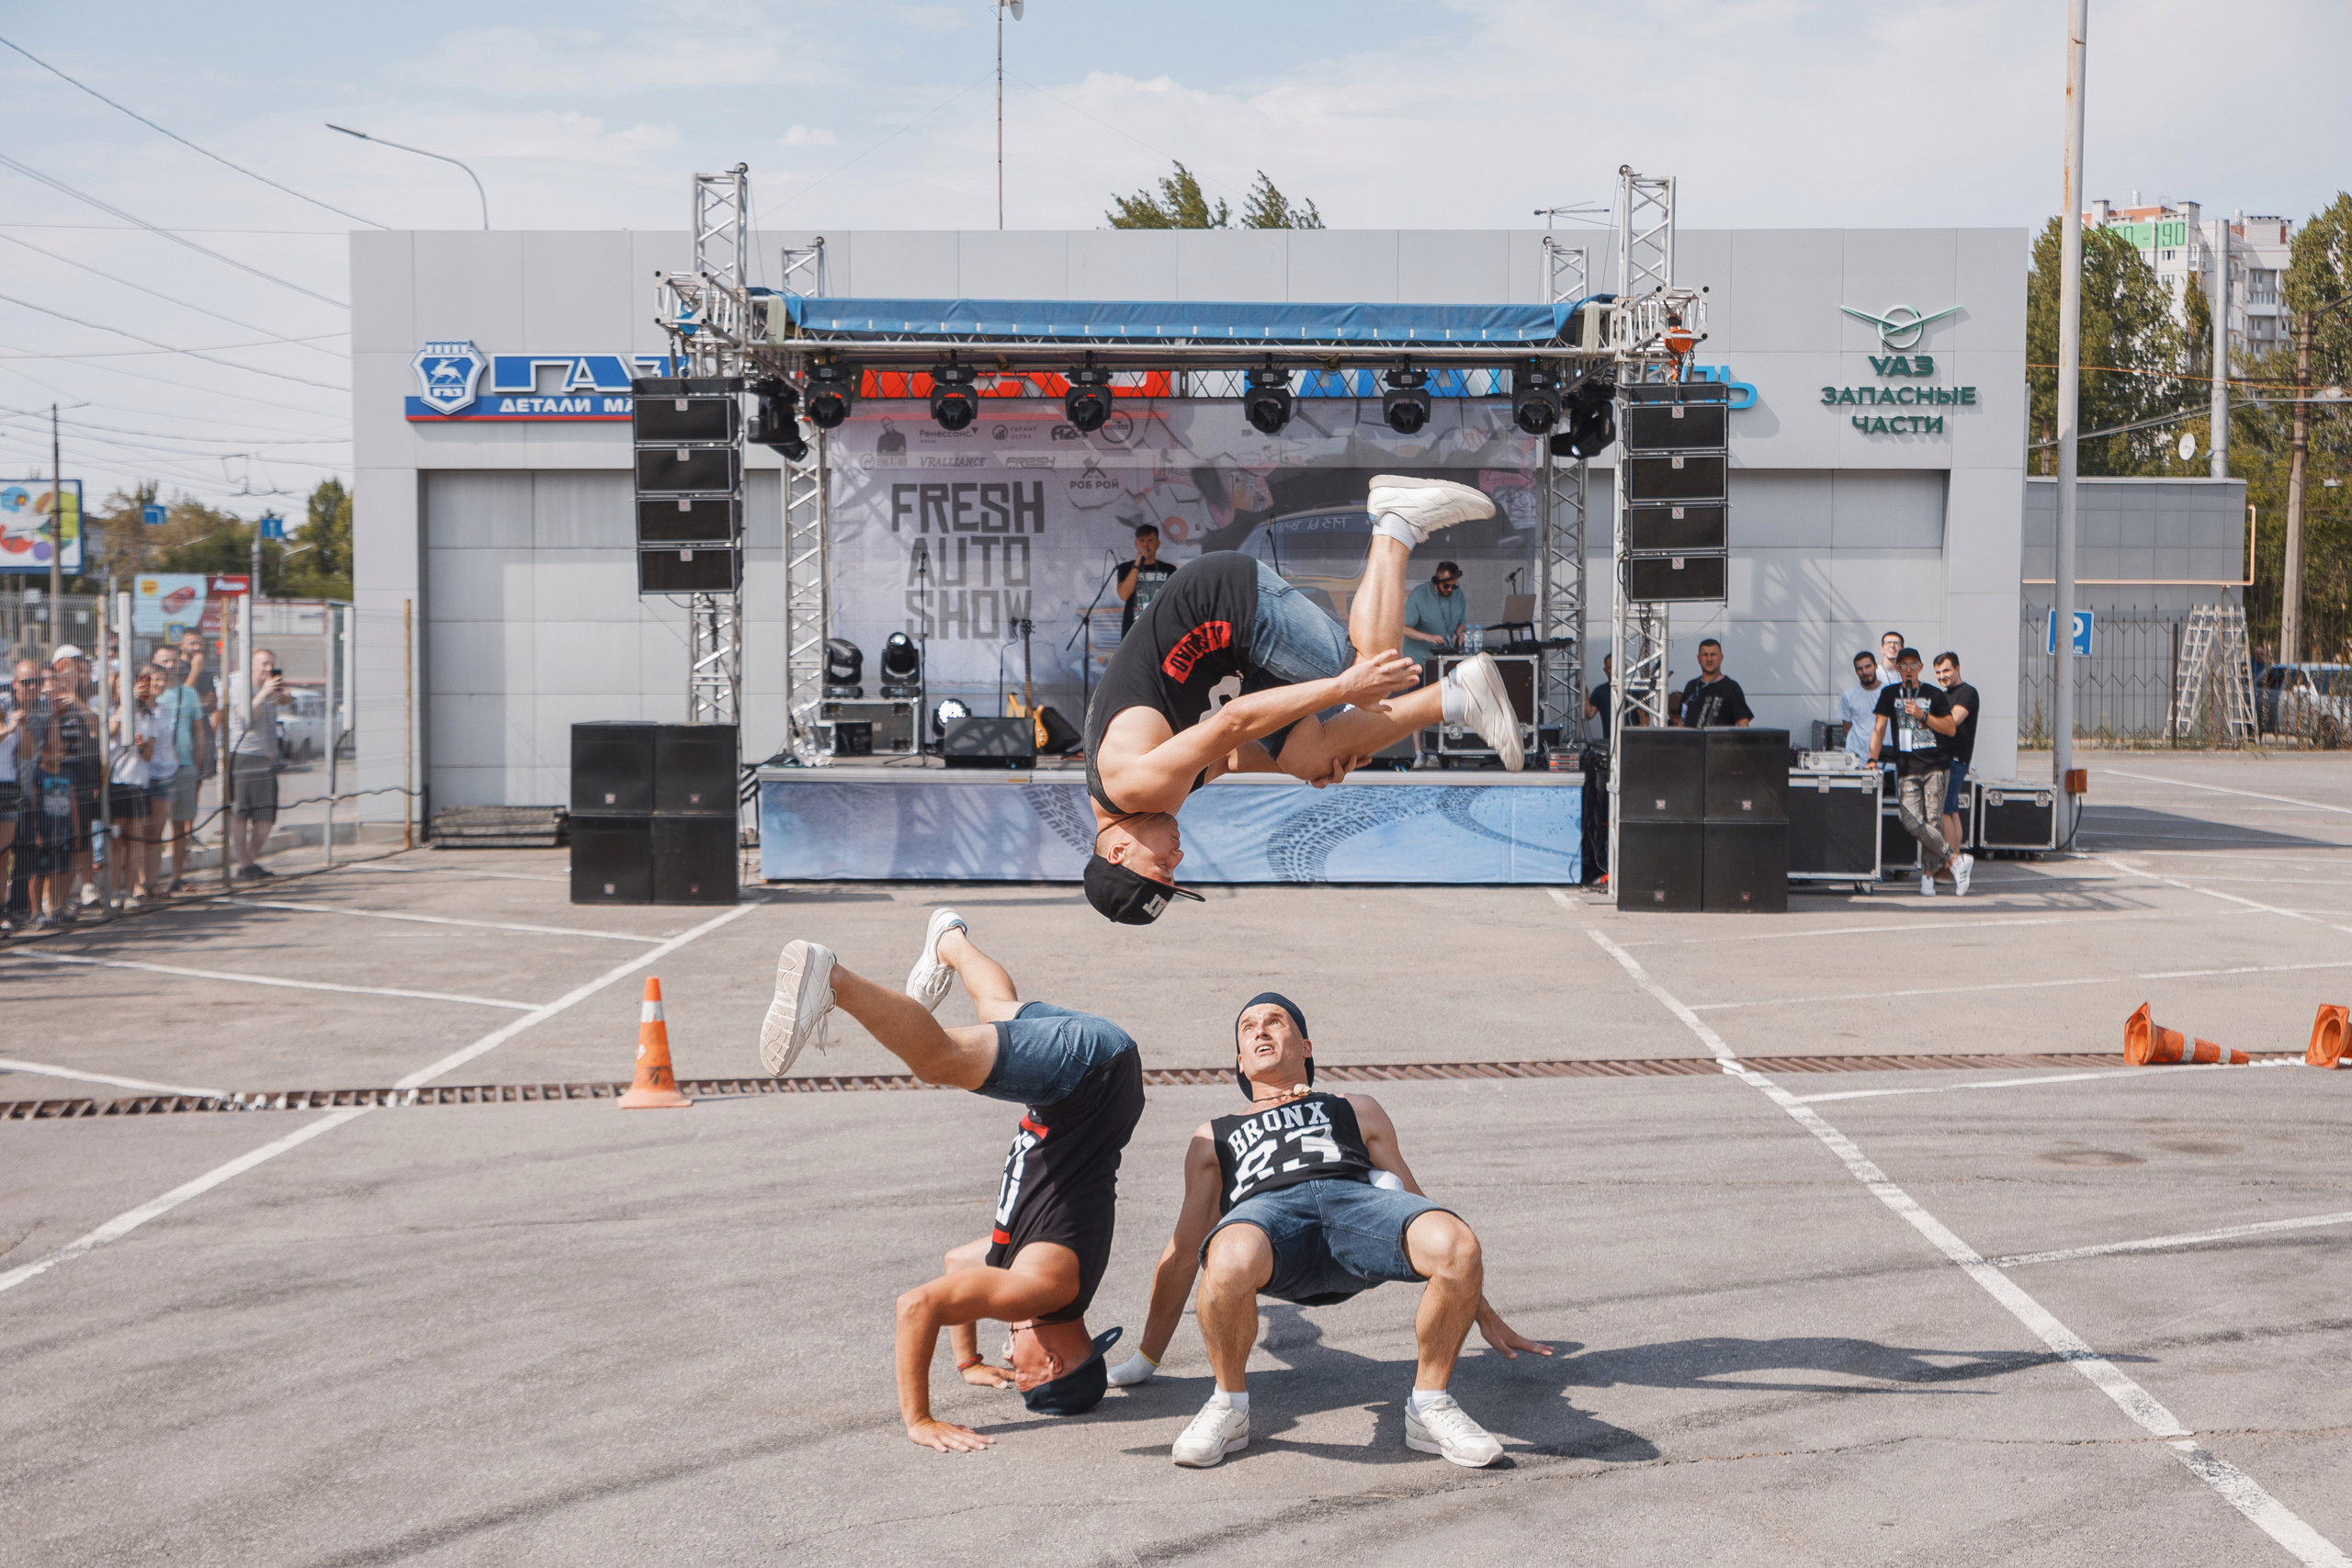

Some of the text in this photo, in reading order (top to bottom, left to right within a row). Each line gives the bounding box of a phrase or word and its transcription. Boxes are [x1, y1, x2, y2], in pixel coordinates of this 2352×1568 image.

[1868, 355, 1935, 378] УАЗ
[499, 398, 591, 413] ДЕТАЛИ
[1820, 387, 1977, 405] ЗАПАСНЫЕ
[1851, 415, 1943, 434] ЧАСТИ
[920, 457, 986, 468] VRALLIANCE
[1069, 479, 1119, 490] РОБ РОЙ
[891, 481, 1045, 534] FRESH
[907, 536, 1032, 588] AUTO
[905, 590, 1033, 640] SHOW
[1227, 1101, 1330, 1162] BRONX
